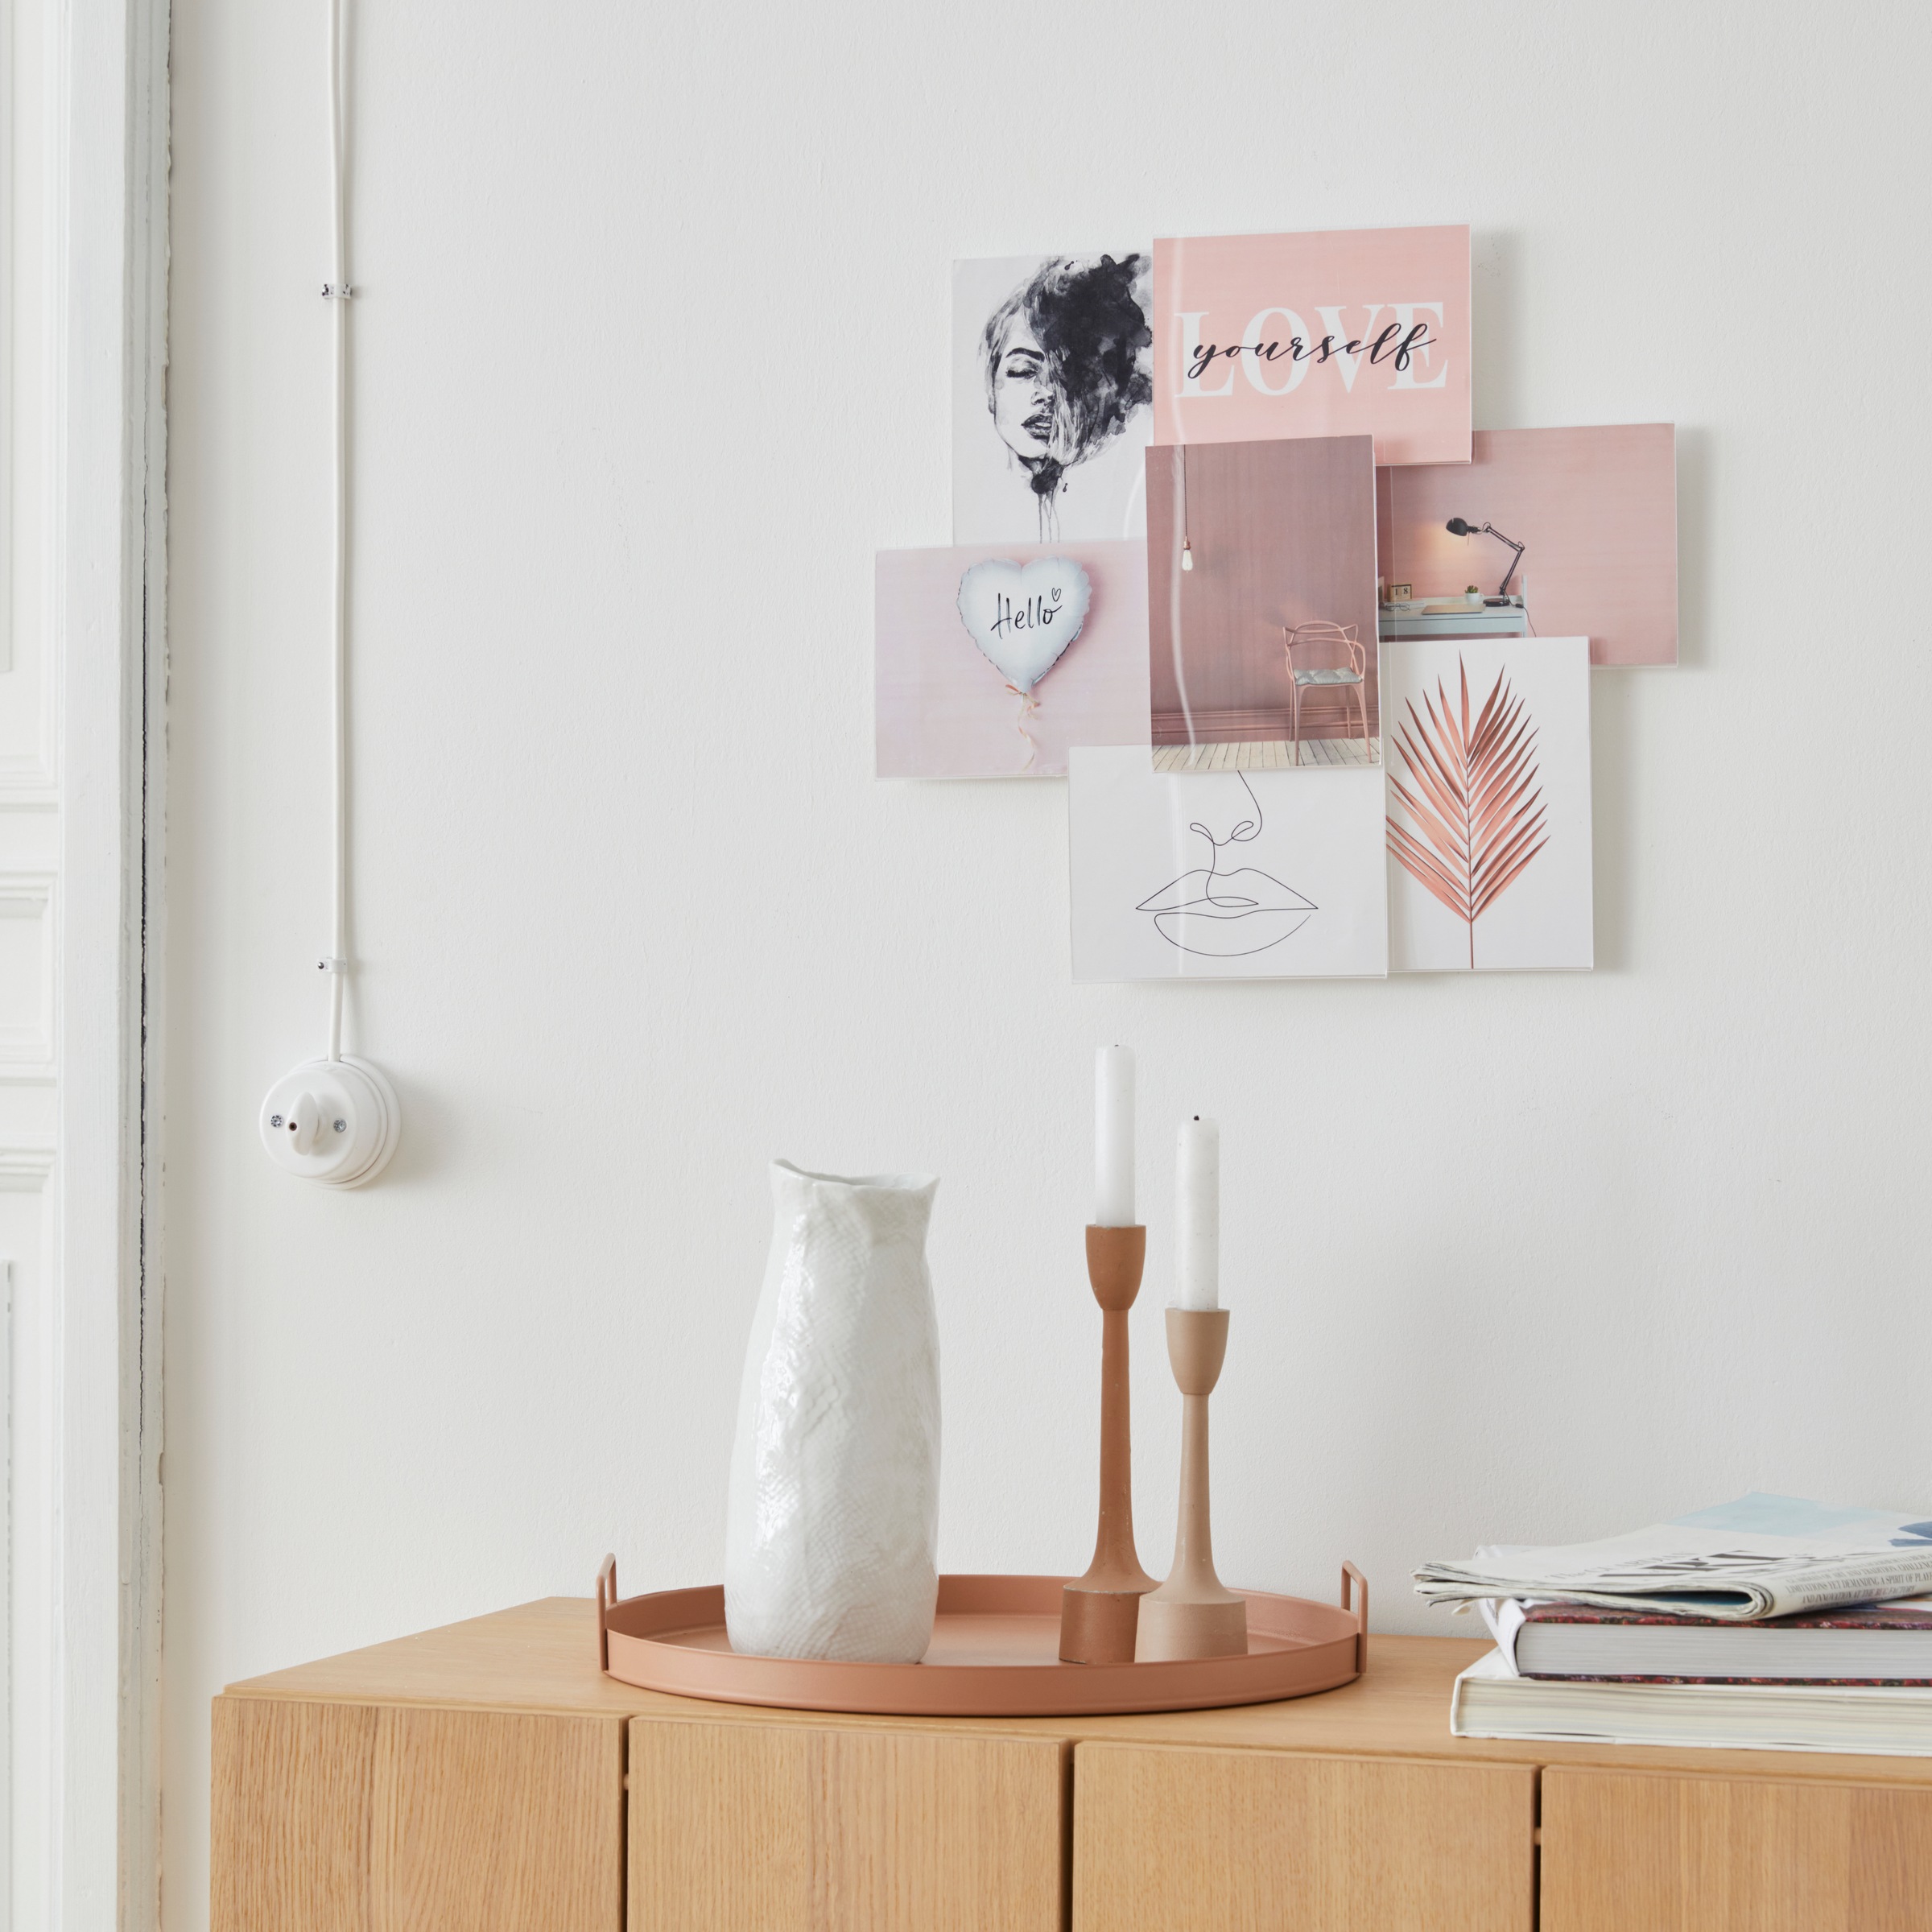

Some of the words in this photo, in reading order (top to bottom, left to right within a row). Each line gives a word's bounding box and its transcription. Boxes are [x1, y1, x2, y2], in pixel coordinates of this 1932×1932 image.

[1174, 302, 1448, 398] LOVE
[1187, 323, 1437, 379] yourself
[991, 592, 1063, 640] Hello
